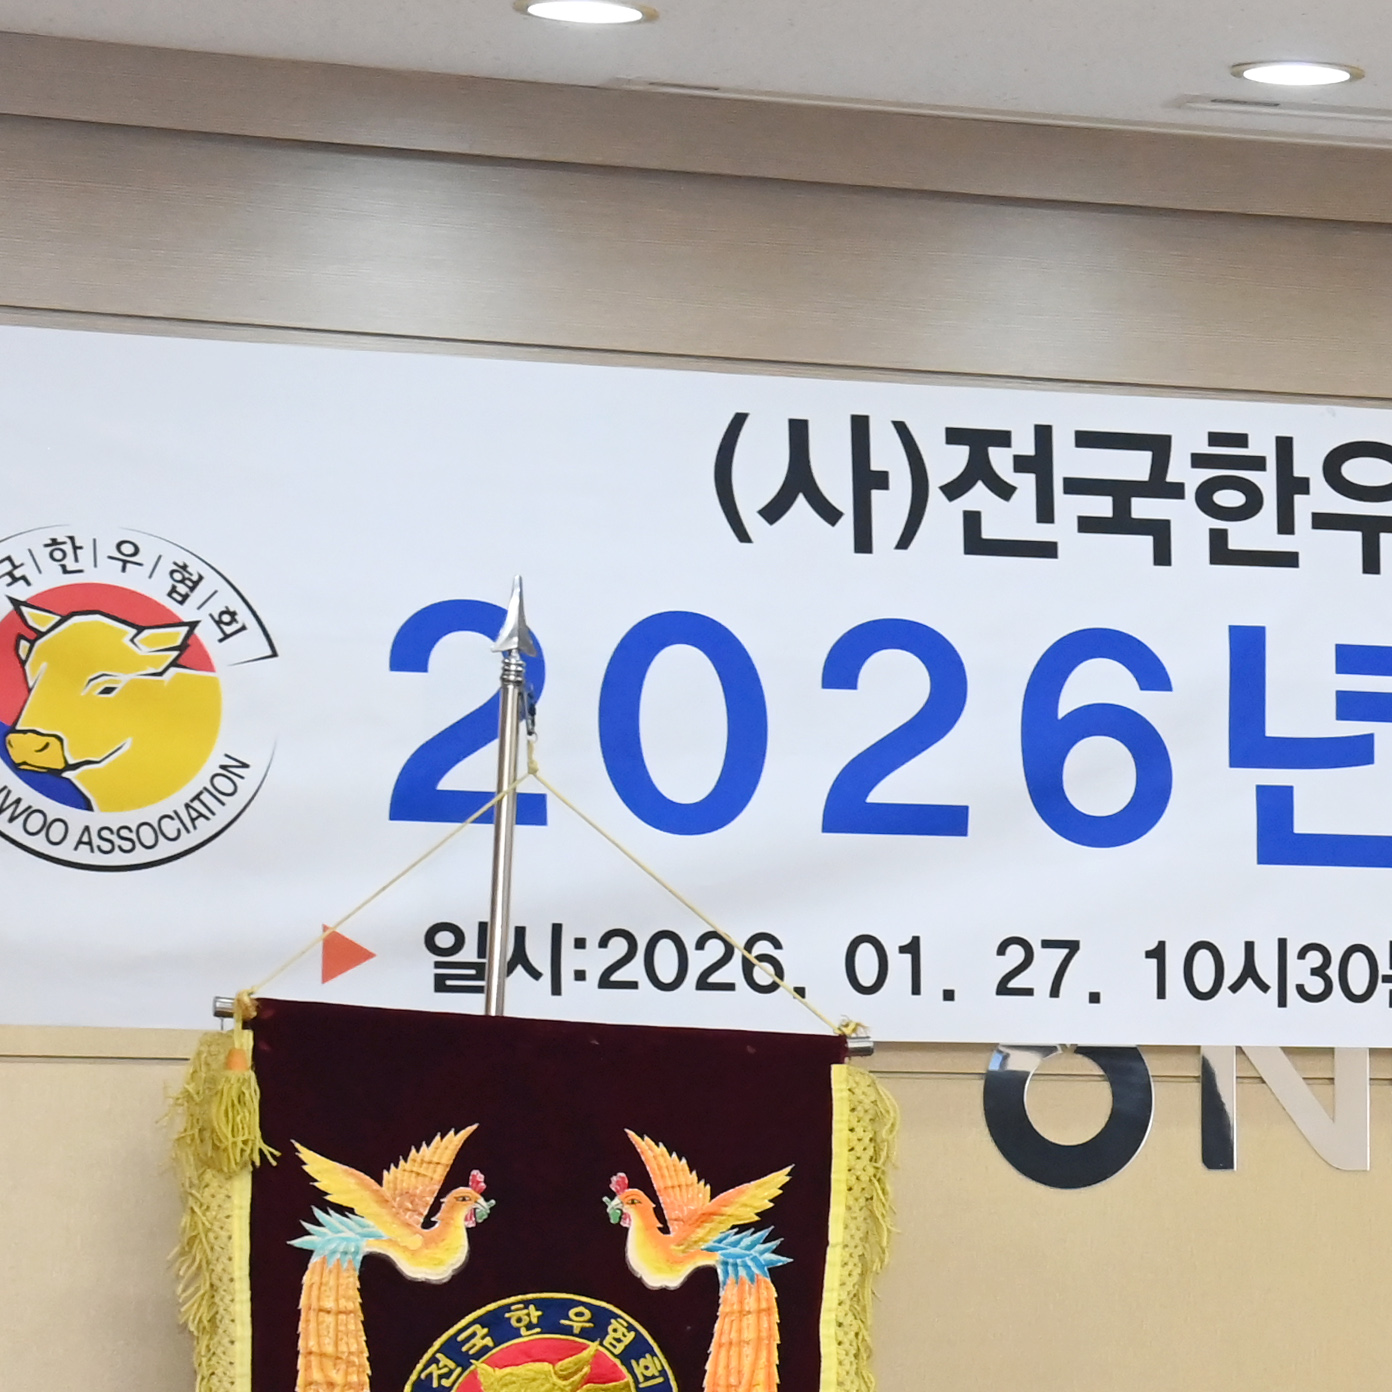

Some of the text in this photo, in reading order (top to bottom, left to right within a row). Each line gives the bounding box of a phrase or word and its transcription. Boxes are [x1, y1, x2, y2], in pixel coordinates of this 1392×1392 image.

[74, 753, 251, 855] ASSOCIATION
[423, 920, 806, 999] 일시:2026.
[845, 933, 956, 1002] 01.
[995, 935, 1101, 1004] 27.
[420, 1303, 665, 1388] 전국한우협회
